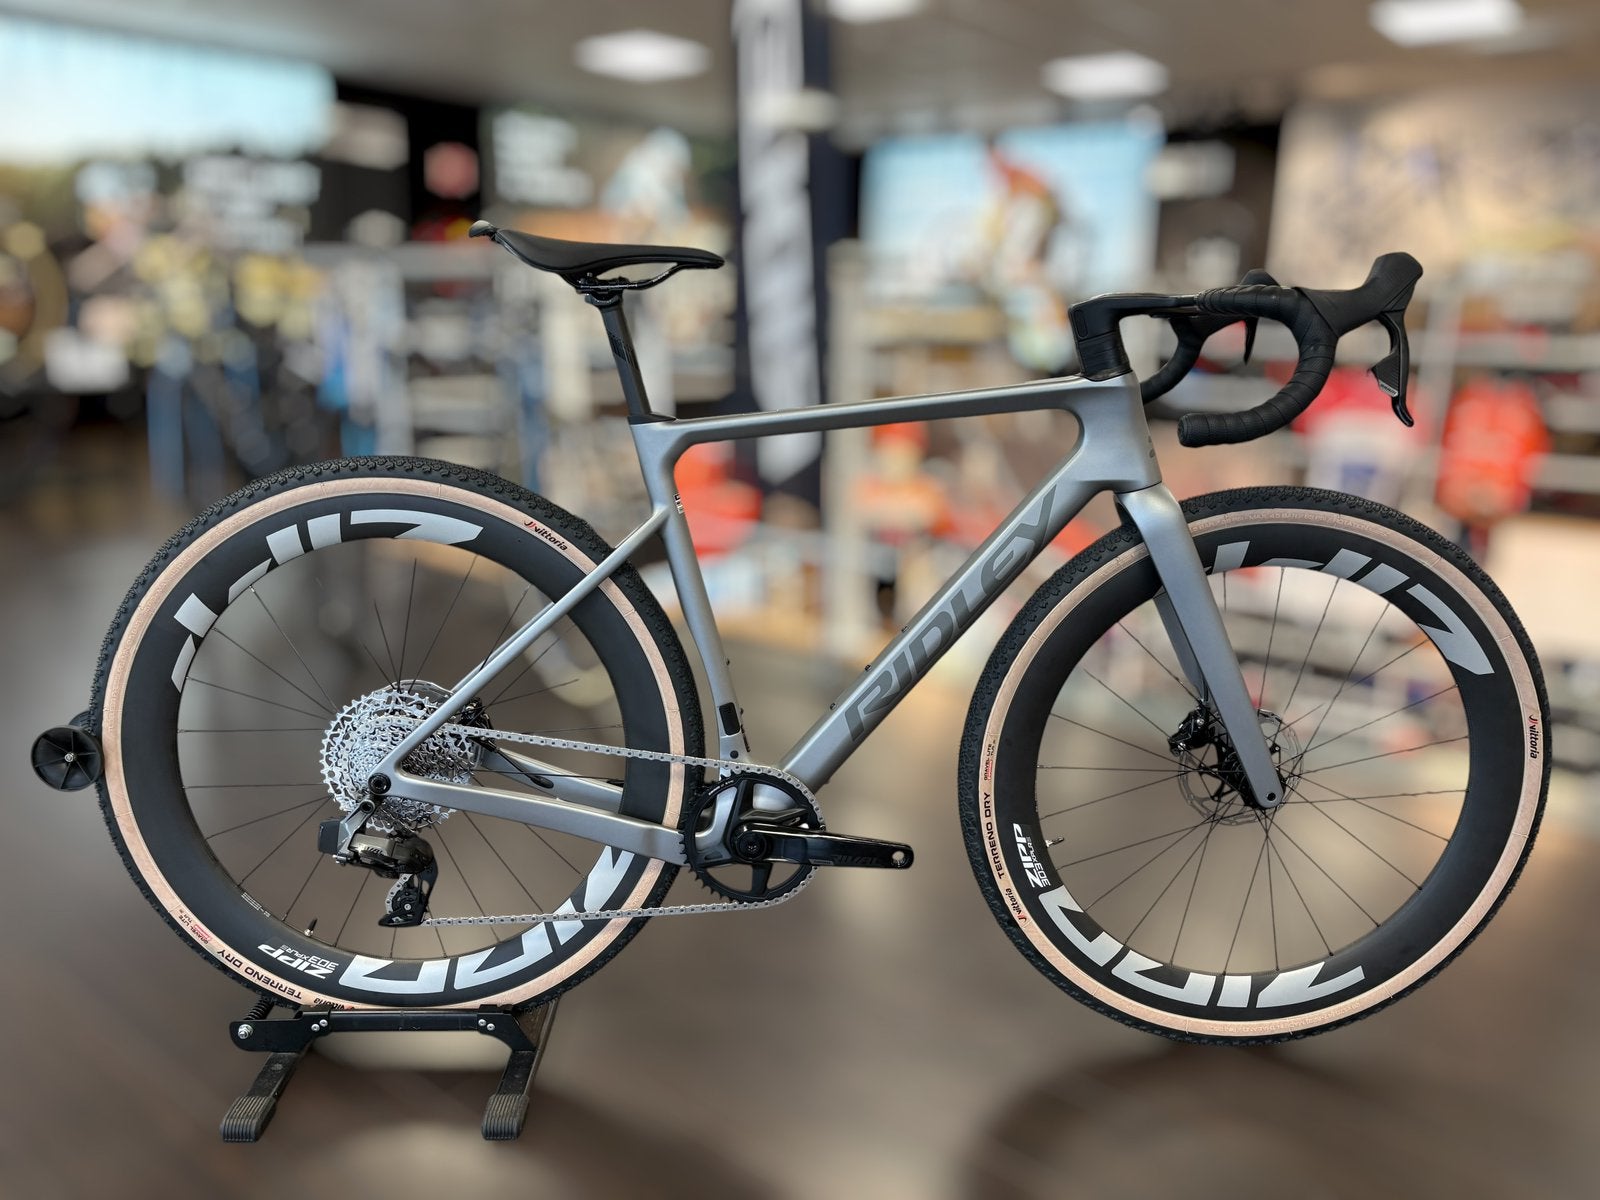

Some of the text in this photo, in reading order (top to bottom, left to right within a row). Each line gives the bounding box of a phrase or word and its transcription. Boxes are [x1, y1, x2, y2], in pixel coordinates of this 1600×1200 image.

[534, 526, 568, 551] vittoria
[844, 483, 1057, 742] RIDLEY
[1529, 725, 1539, 759] vittoria
[983, 793, 1004, 879] TERRENO DRY
[1012, 823, 1043, 889] ZIPP
[1033, 862, 1051, 888] 303
[1005, 887, 1022, 916] vittoria
[217, 949, 302, 999] TERRENO DRY
[257, 943, 334, 980] ZIPP
[308, 955, 339, 971] 303
